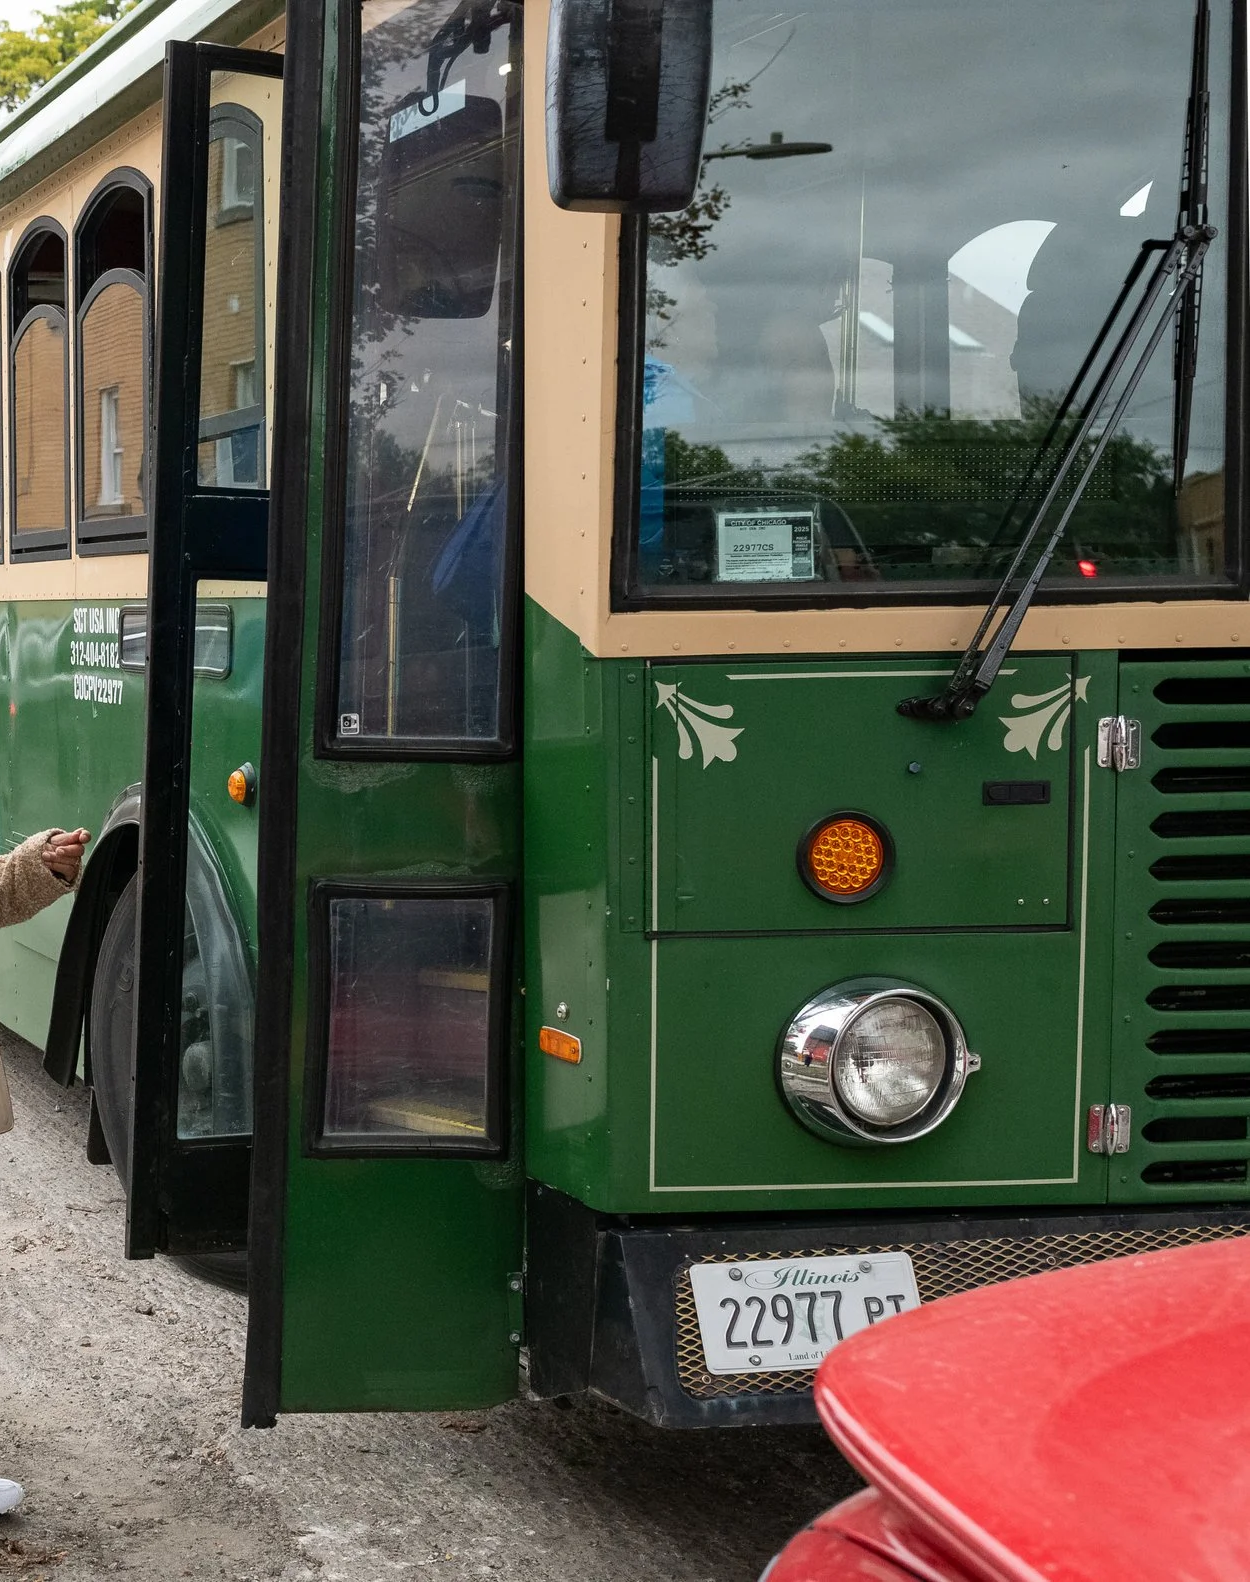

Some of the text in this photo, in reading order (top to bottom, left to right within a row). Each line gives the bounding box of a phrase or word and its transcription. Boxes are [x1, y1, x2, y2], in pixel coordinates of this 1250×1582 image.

[733, 544, 774, 552] 22977CS
[73, 607, 120, 634] SCT USA INC
[70, 641, 120, 668] 312-404-8182
[74, 674, 124, 705] COCPV22977
[744, 1265, 861, 1290] Illinois
[719, 1290, 906, 1349] 22977 PT
[788, 1351, 810, 1361] Land
[810, 1351, 819, 1359] of
